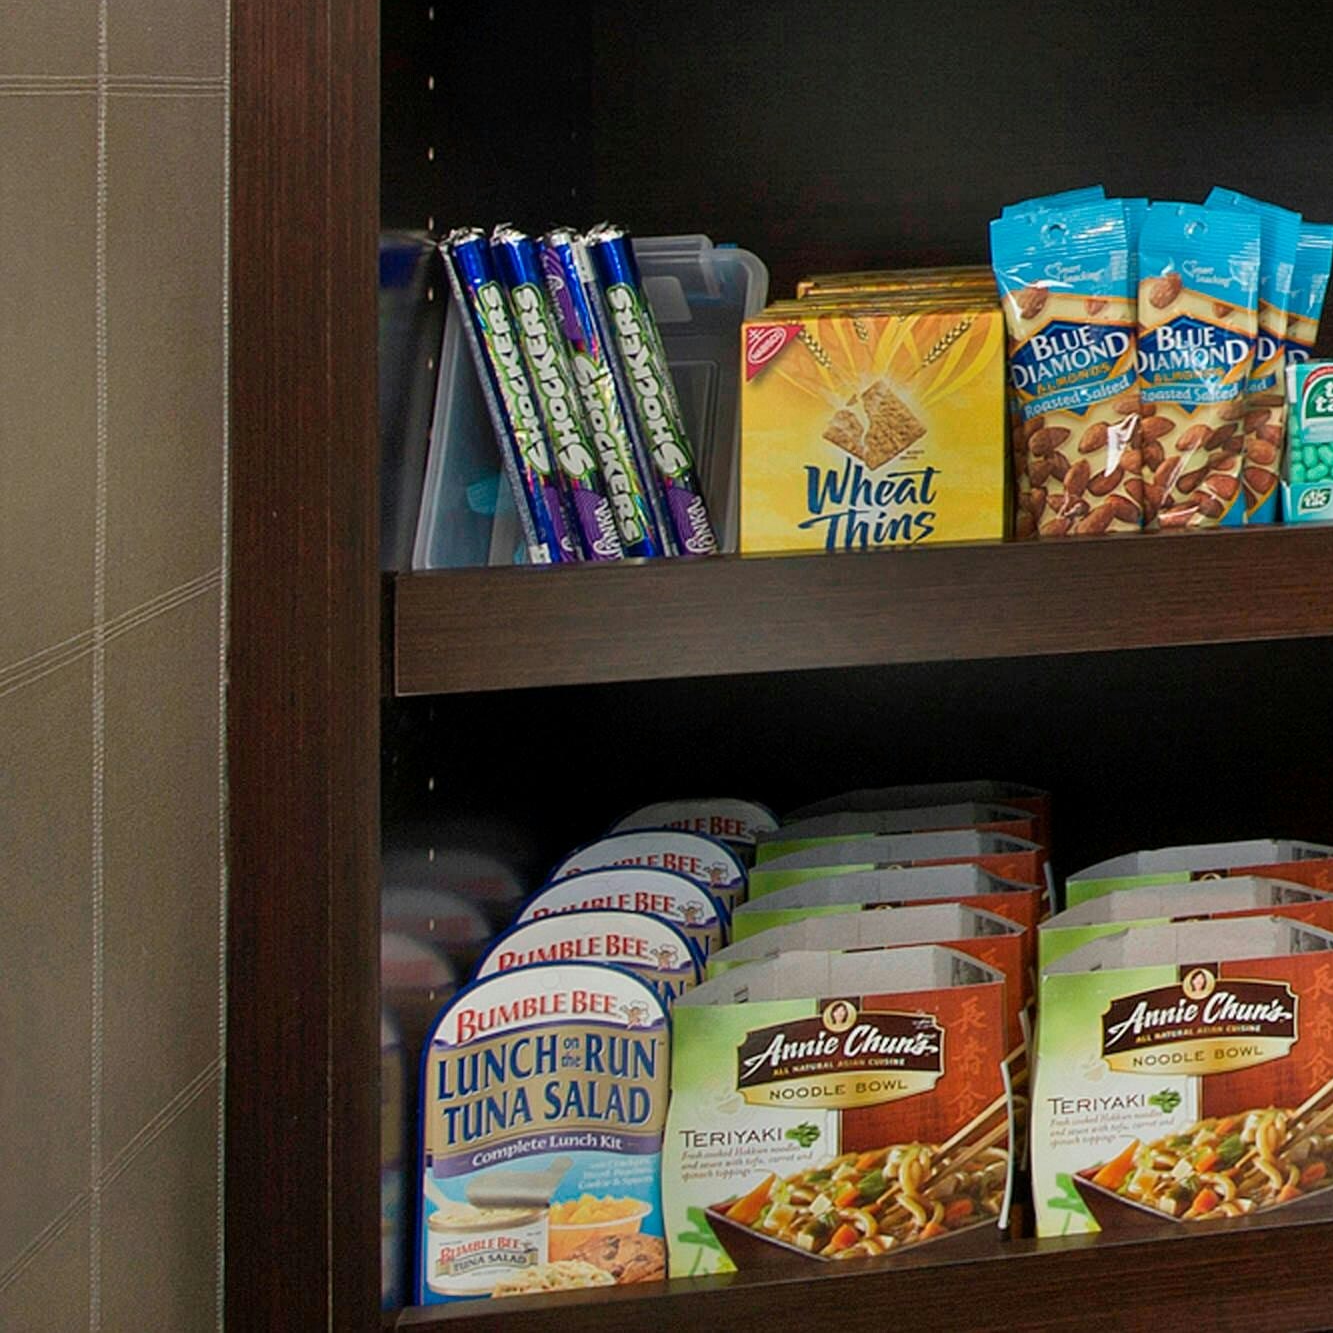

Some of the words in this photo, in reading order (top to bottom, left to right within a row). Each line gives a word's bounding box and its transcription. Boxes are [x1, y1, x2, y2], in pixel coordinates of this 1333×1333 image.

[1031, 326, 1095, 361] BLUE
[1156, 326, 1216, 351] BLUE
[1012, 333, 1130, 390] DIAMOND
[512, 285, 596, 475] SHOCKERS
[607, 286, 690, 475] SHOCKERS
[1141, 390, 1191, 404] Roasted
[1193, 383, 1239, 402] Salted
[573, 353, 645, 543] SHOCKERS
[803, 456, 942, 515] Wheat
[797, 509, 937, 552] Thins
[662, 853, 702, 875] BEE
[456, 992, 567, 1045] BUMBLE
[571, 990, 619, 1015] BEE
[1104, 997, 1199, 1049] Annie
[1203, 991, 1293, 1025] Chun's
[1135, 1034, 1152, 1044] ALL
[1155, 1029, 1194, 1041] NATURAL
[1226, 1024, 1261, 1033] CUISINE
[437, 1034, 558, 1101] LUNCH
[562, 1037, 580, 1050] on
[584, 1033, 657, 1079] RUN
[561, 1054, 581, 1067] the
[741, 1030, 838, 1080] Annie
[843, 1024, 939, 1056] Chun's
[772, 1068, 790, 1078] ALL
[793, 1062, 835, 1074] NATURAL
[868, 1057, 905, 1067] CUISINE
[1132, 1050, 1206, 1067] NOODLE
[1214, 1045, 1264, 1060] BOWL
[768, 1084, 847, 1102] NOODLE
[856, 1079, 909, 1094] BOWL
[1047, 1093, 1145, 1116] TERIYAKI
[443, 1086, 533, 1146] TUNA
[544, 1080, 651, 1126] SALAD
[472, 1137, 548, 1168] Complete
[549, 1133, 599, 1150] Lunch
[600, 1134, 623, 1151] Kit
[678, 1126, 783, 1149] TERIYAKI
[439, 1237, 496, 1264] BUMBLE
[497, 1236, 521, 1250] BEE
[454, 1256, 486, 1272] TUNA
[488, 1253, 528, 1265] SALAD
